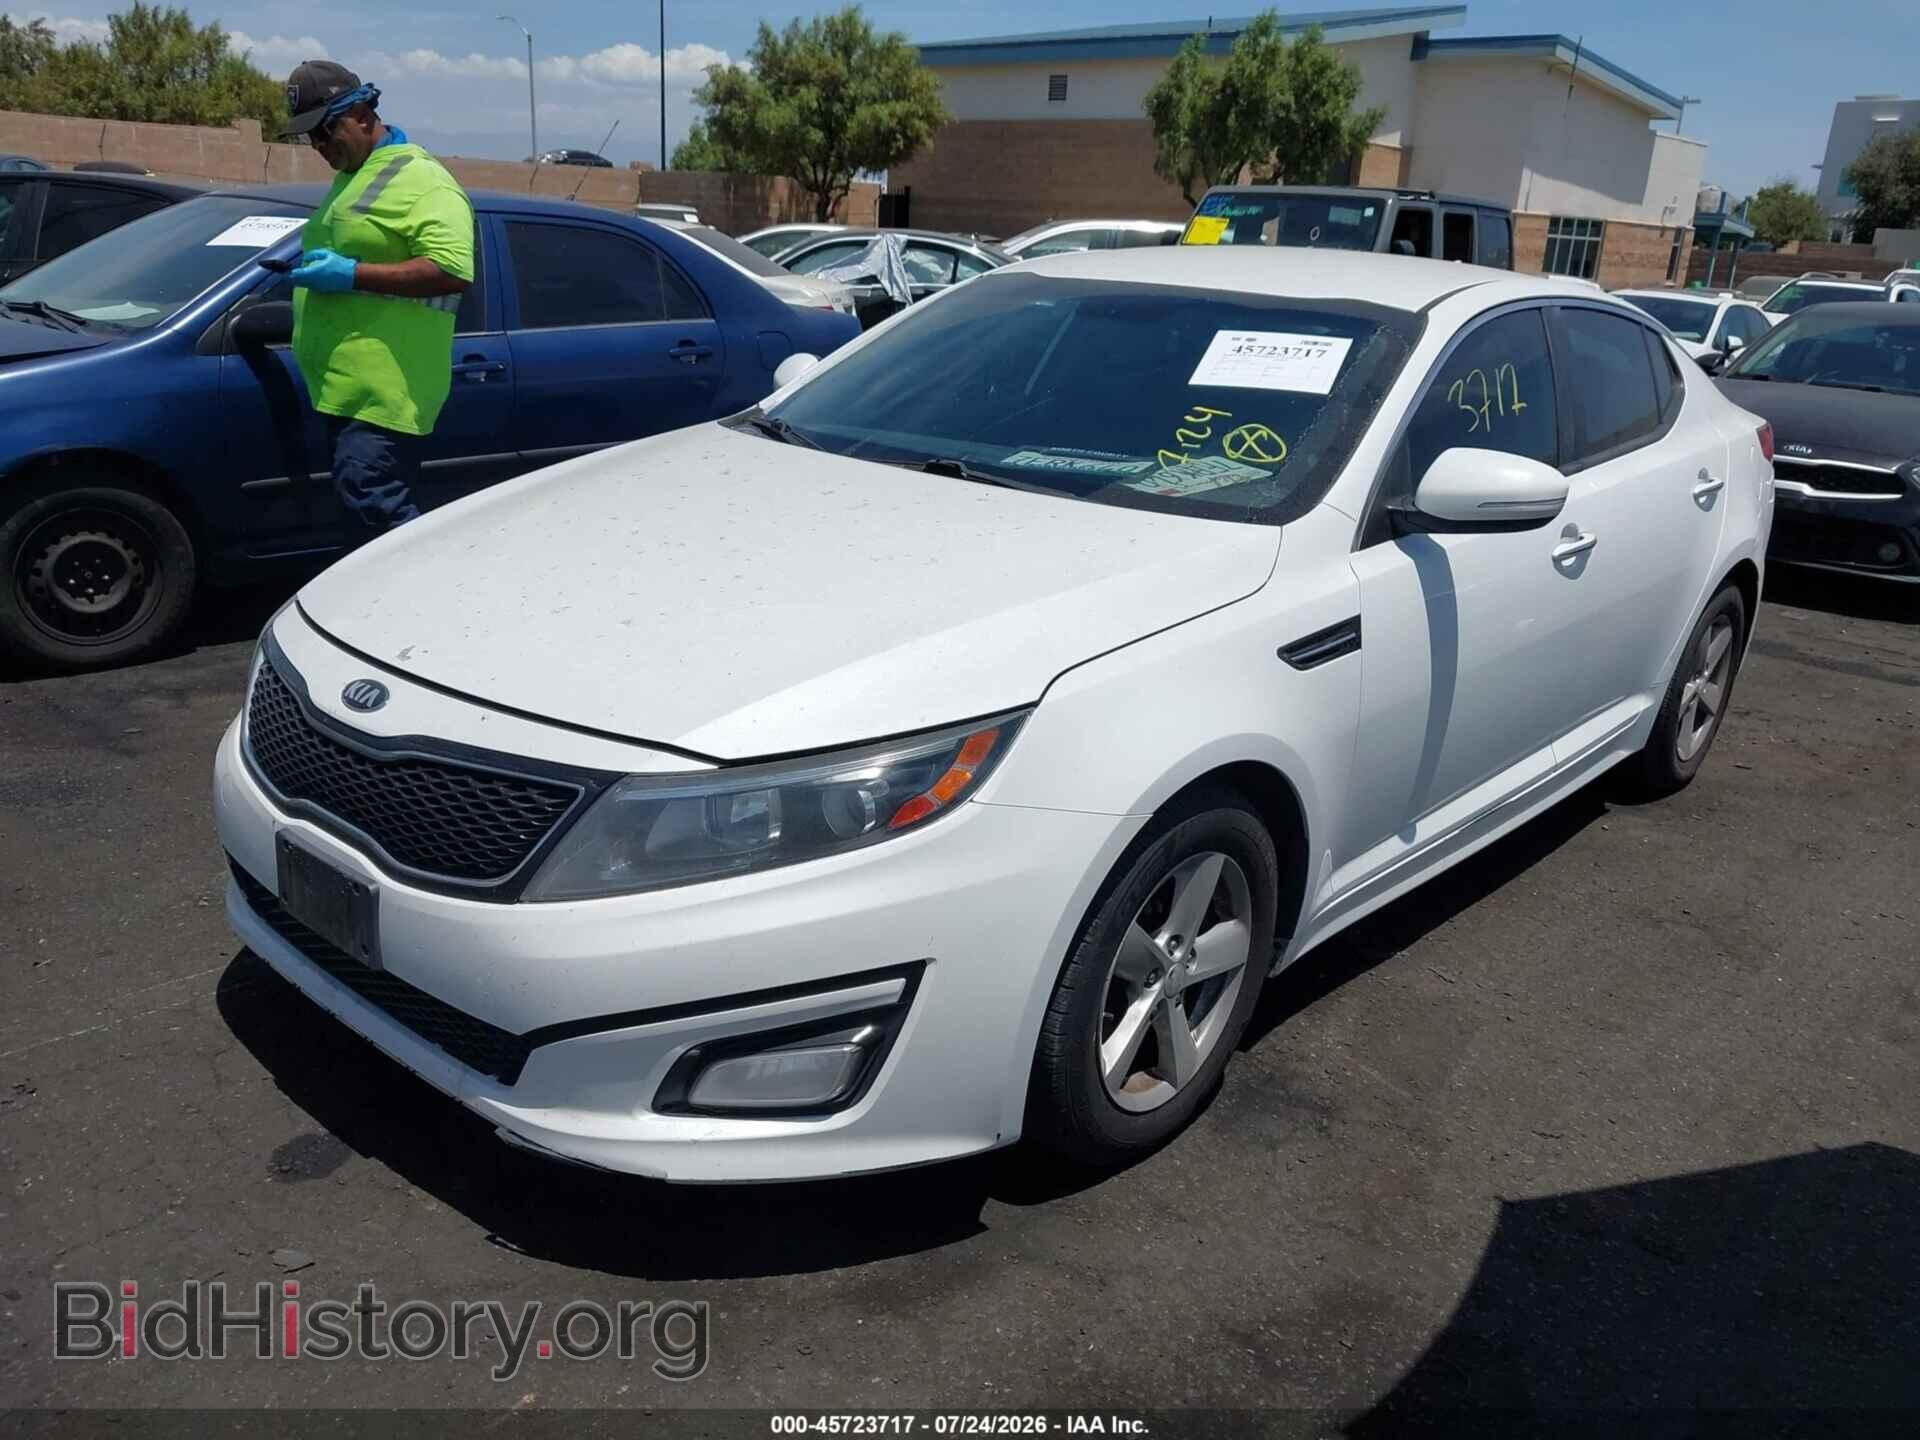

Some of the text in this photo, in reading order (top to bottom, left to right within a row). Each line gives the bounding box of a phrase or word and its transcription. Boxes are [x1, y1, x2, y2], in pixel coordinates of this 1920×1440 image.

[1231, 345, 1327, 358] 45723717
[1447, 363, 1528, 432] 3717
[344, 681, 380, 707] KIA
